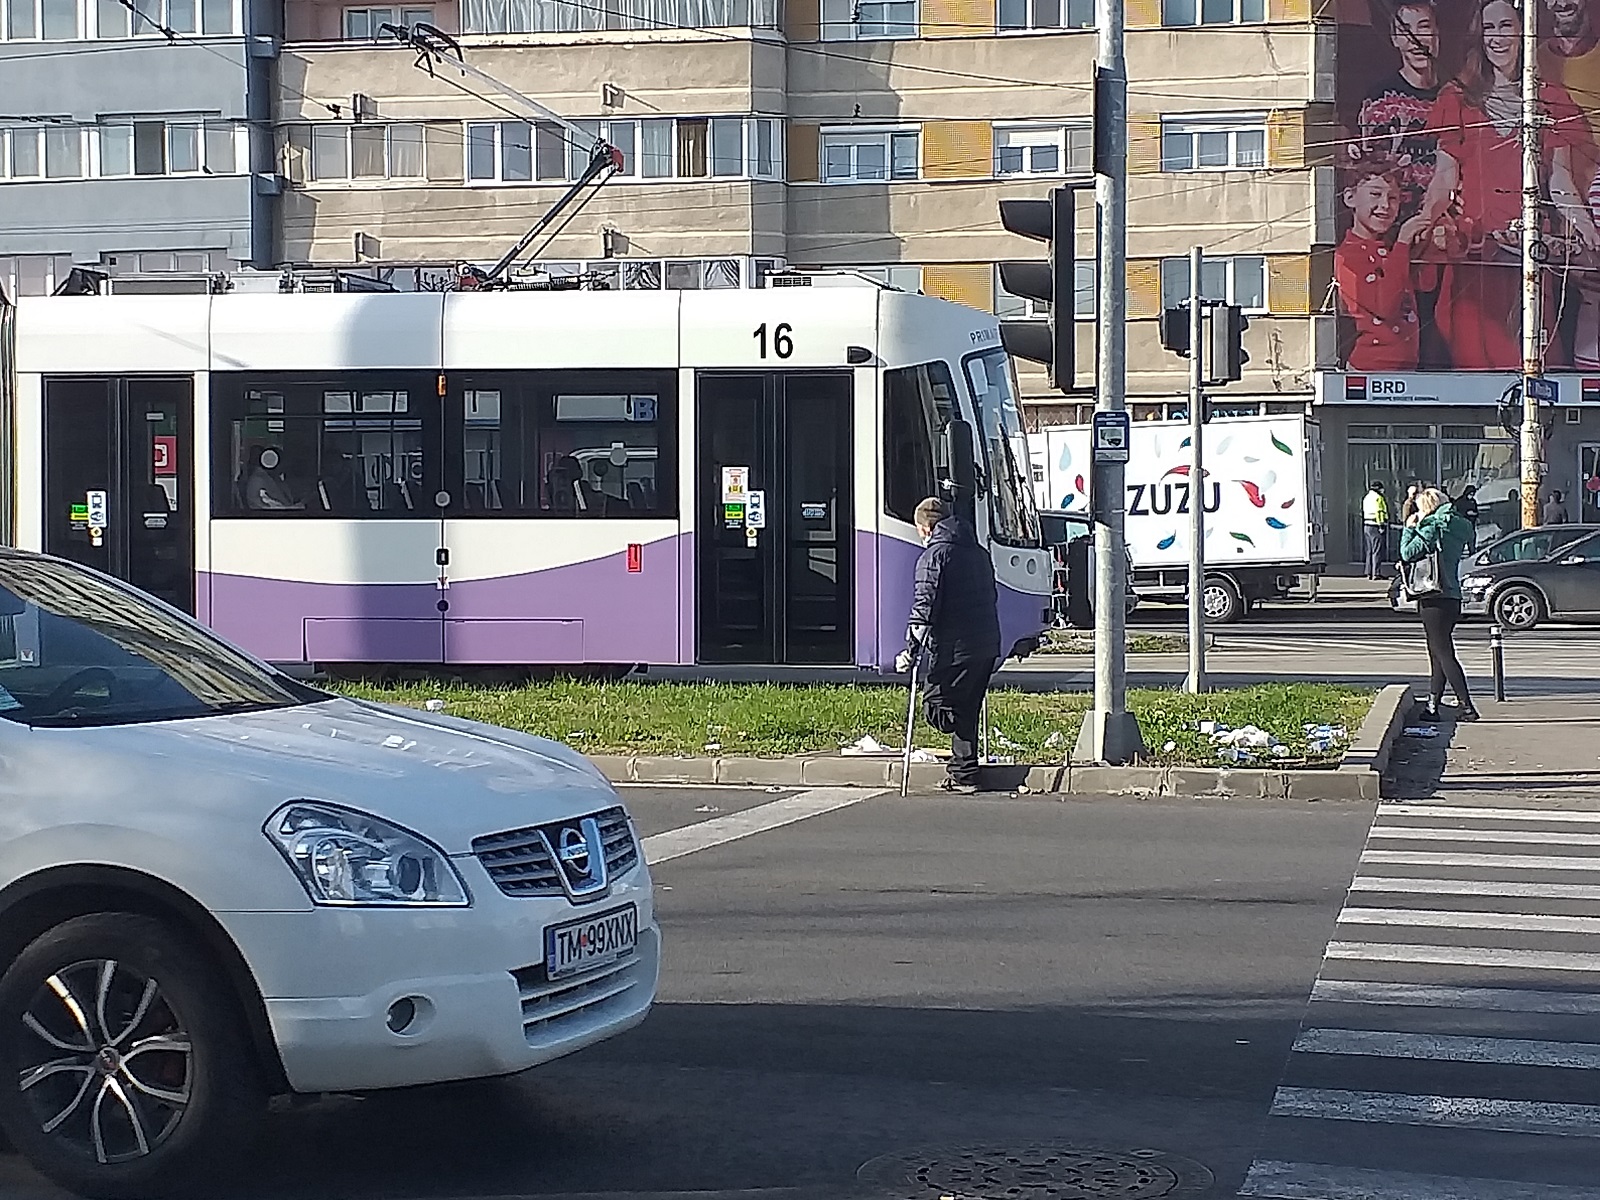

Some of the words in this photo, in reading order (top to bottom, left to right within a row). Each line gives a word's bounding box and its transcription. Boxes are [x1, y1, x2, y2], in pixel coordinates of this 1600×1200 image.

[753, 322, 794, 359] 16
[1371, 380, 1406, 394] BRD
[1126, 481, 1221, 516] ZUZU
